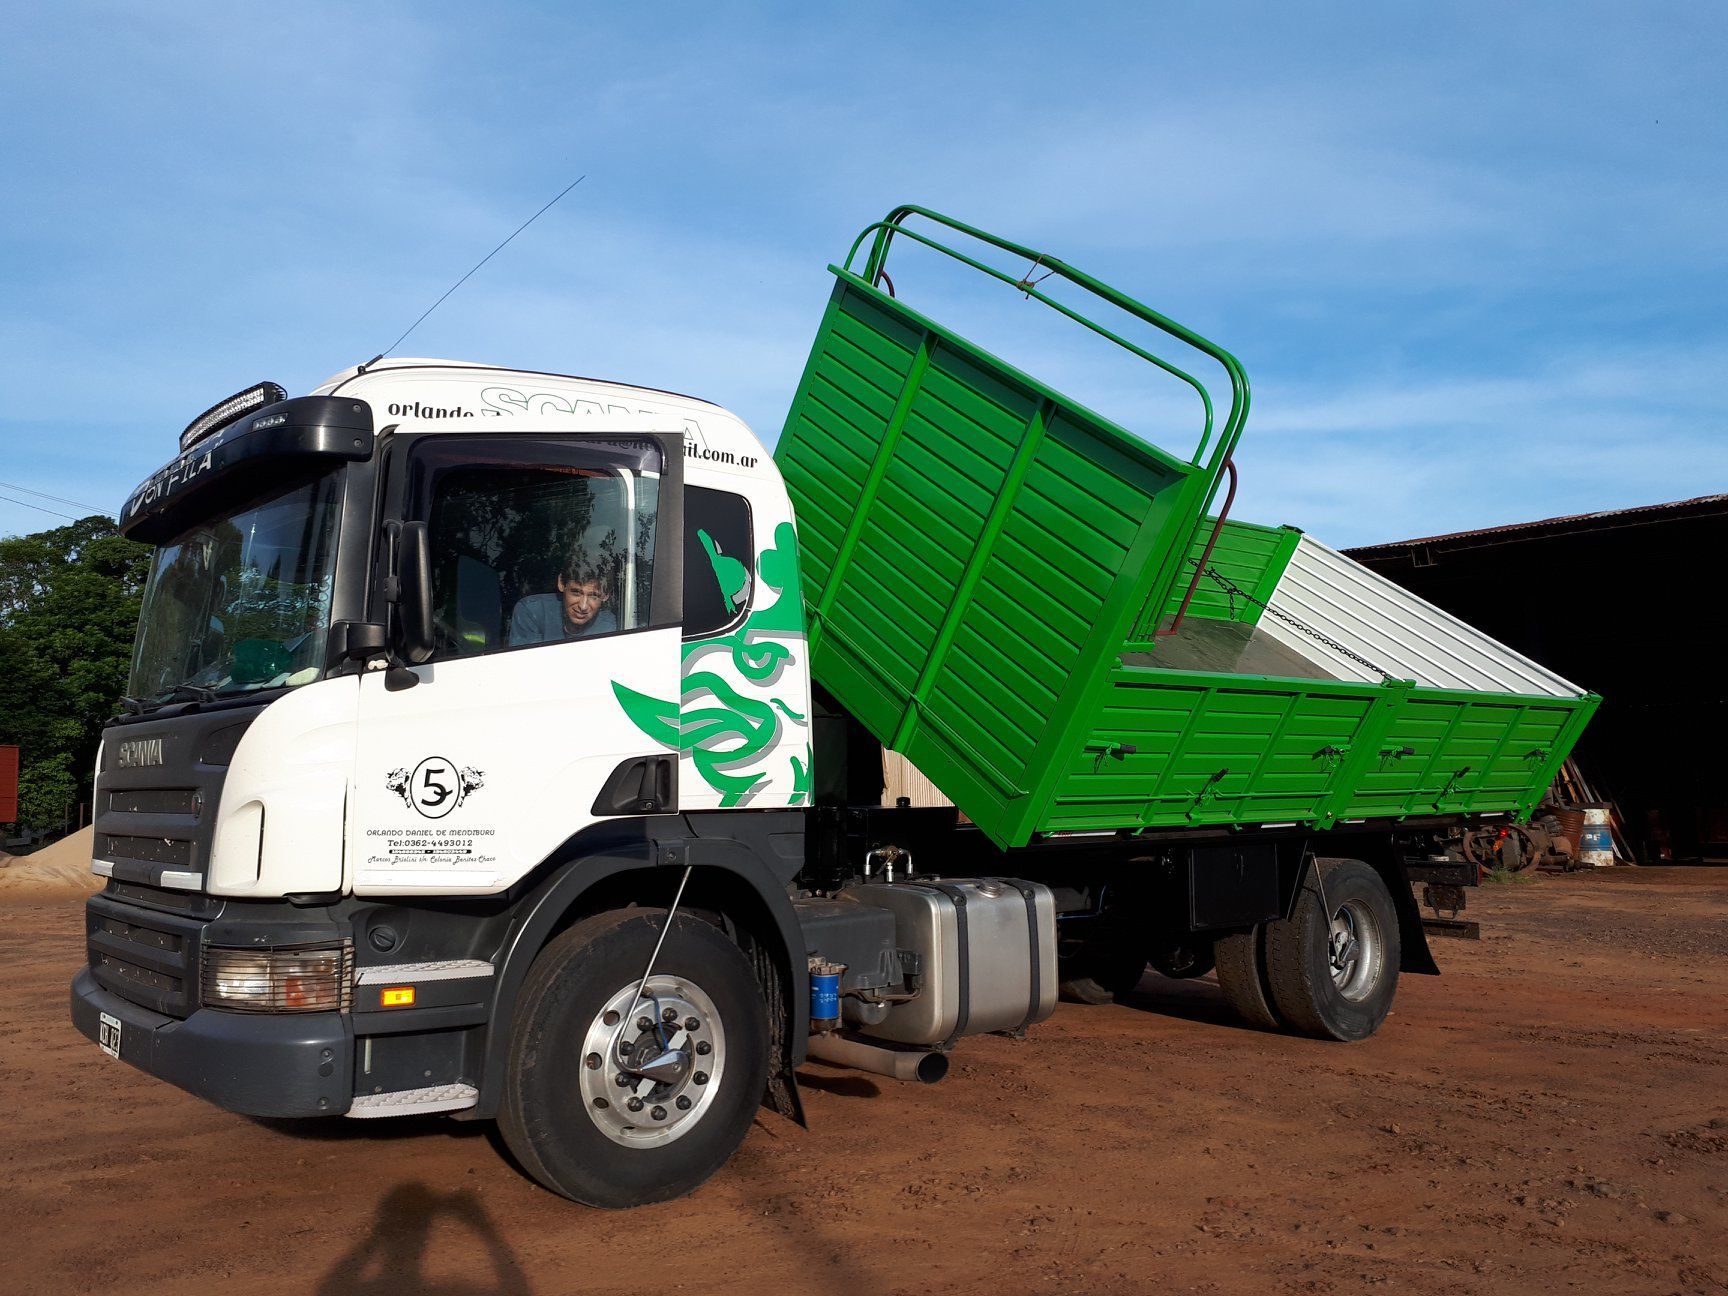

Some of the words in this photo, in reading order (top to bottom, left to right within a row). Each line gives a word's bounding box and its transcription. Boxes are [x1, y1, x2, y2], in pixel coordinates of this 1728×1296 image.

[119, 738, 163, 768] SCANIA
[366, 829, 403, 837] ORLANDO
[405, 829, 434, 837] DANIEL
[436, 829, 447, 837] DE
[449, 829, 496, 837] MENDIBURU
